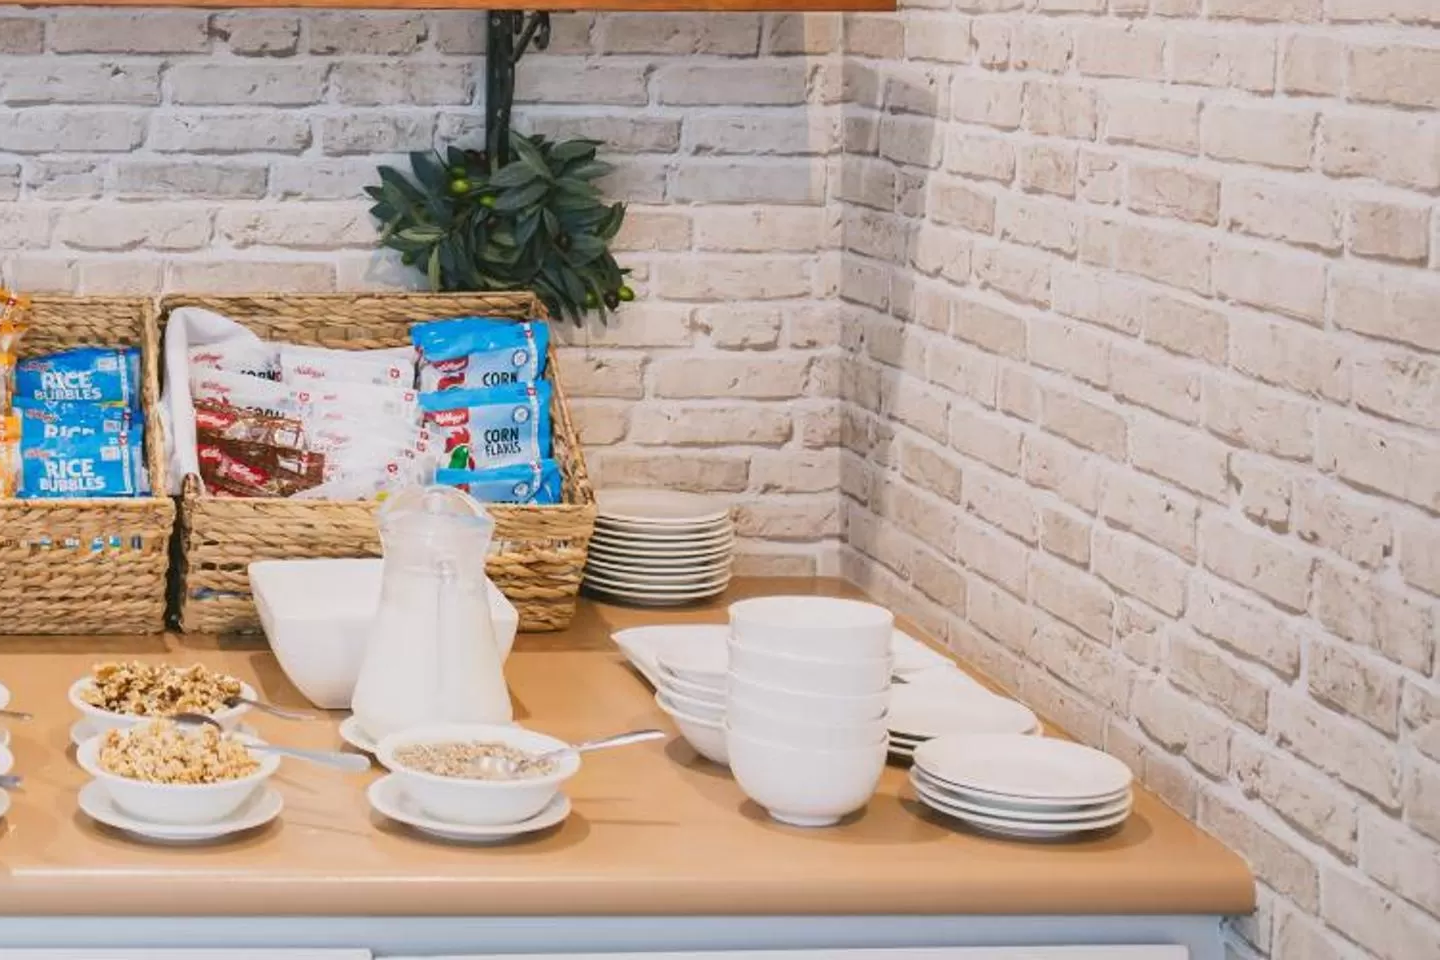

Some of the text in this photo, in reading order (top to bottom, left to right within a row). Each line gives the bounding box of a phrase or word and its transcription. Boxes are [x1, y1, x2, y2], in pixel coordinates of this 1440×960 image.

[41, 371, 93, 390] RICE
[34, 387, 102, 401] BUBBLES
[484, 427, 520, 444] CORN
[45, 459, 95, 478] RICE
[40, 476, 106, 492] BUBBLES
